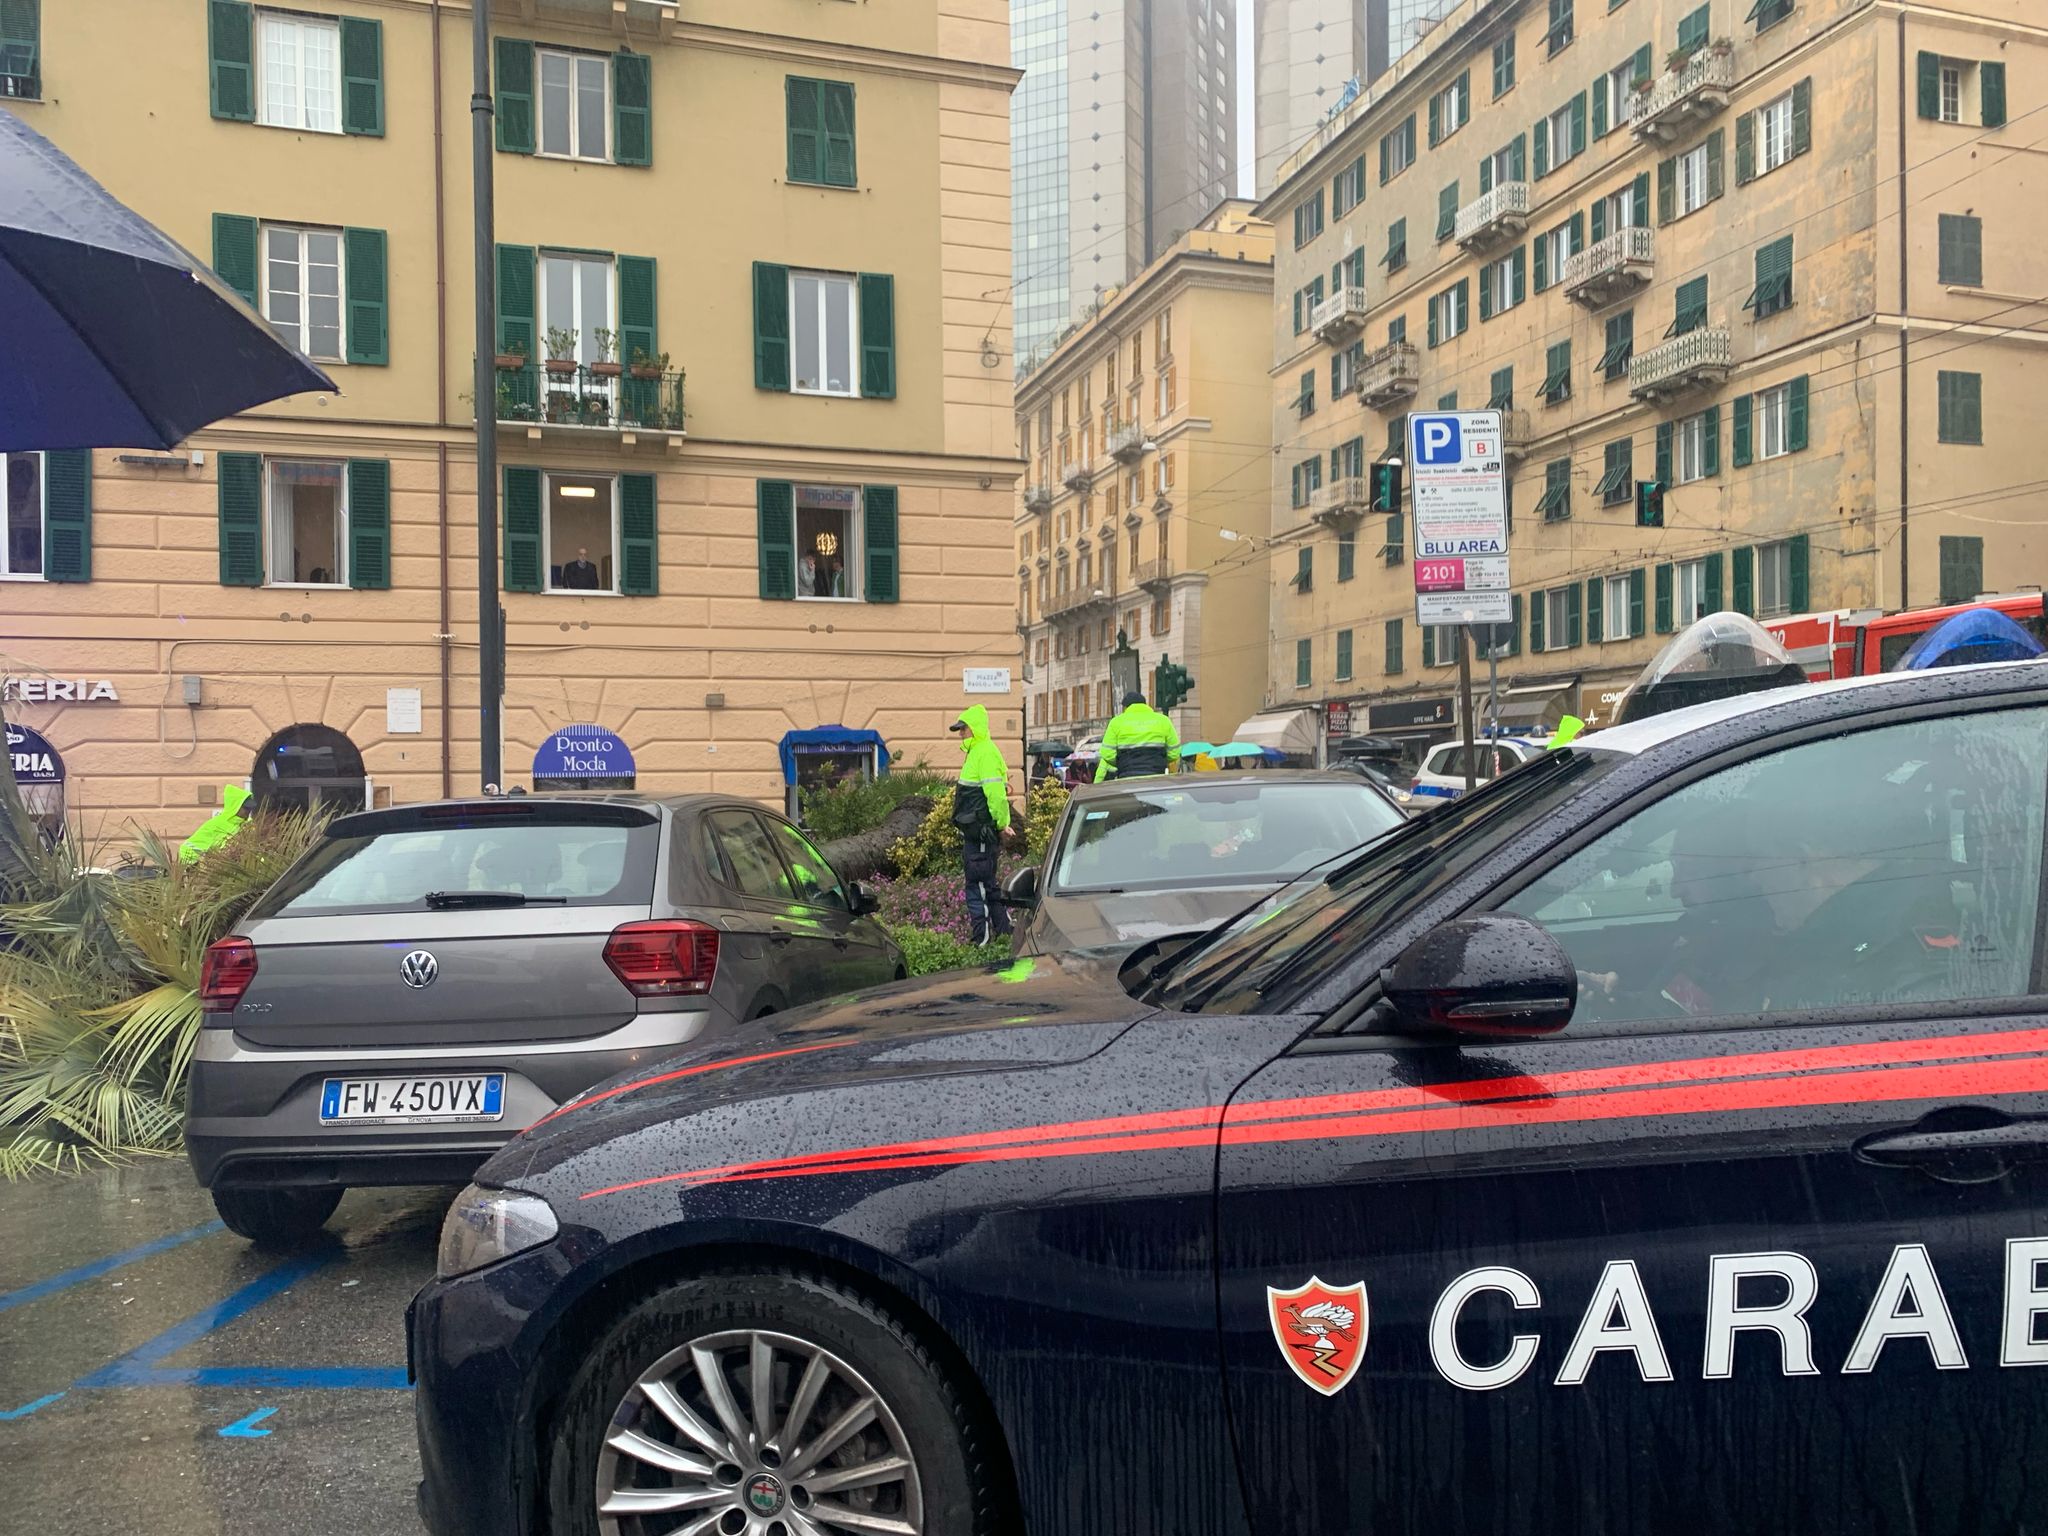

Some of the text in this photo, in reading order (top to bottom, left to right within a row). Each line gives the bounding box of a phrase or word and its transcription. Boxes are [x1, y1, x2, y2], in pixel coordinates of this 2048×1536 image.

[1463, 427, 1499, 435] RESIDENTI
[1423, 422, 1452, 461] P
[1476, 442, 1487, 455] B
[1425, 540, 1500, 554] BLU AREA
[1422, 565, 1456, 581] 2101
[556, 736, 614, 753] Pronto
[563, 754, 608, 772] Moda
[243, 1003, 272, 1012] POLO
[343, 1082, 380, 1114] FW
[390, 1080, 482, 1112] 450VX
